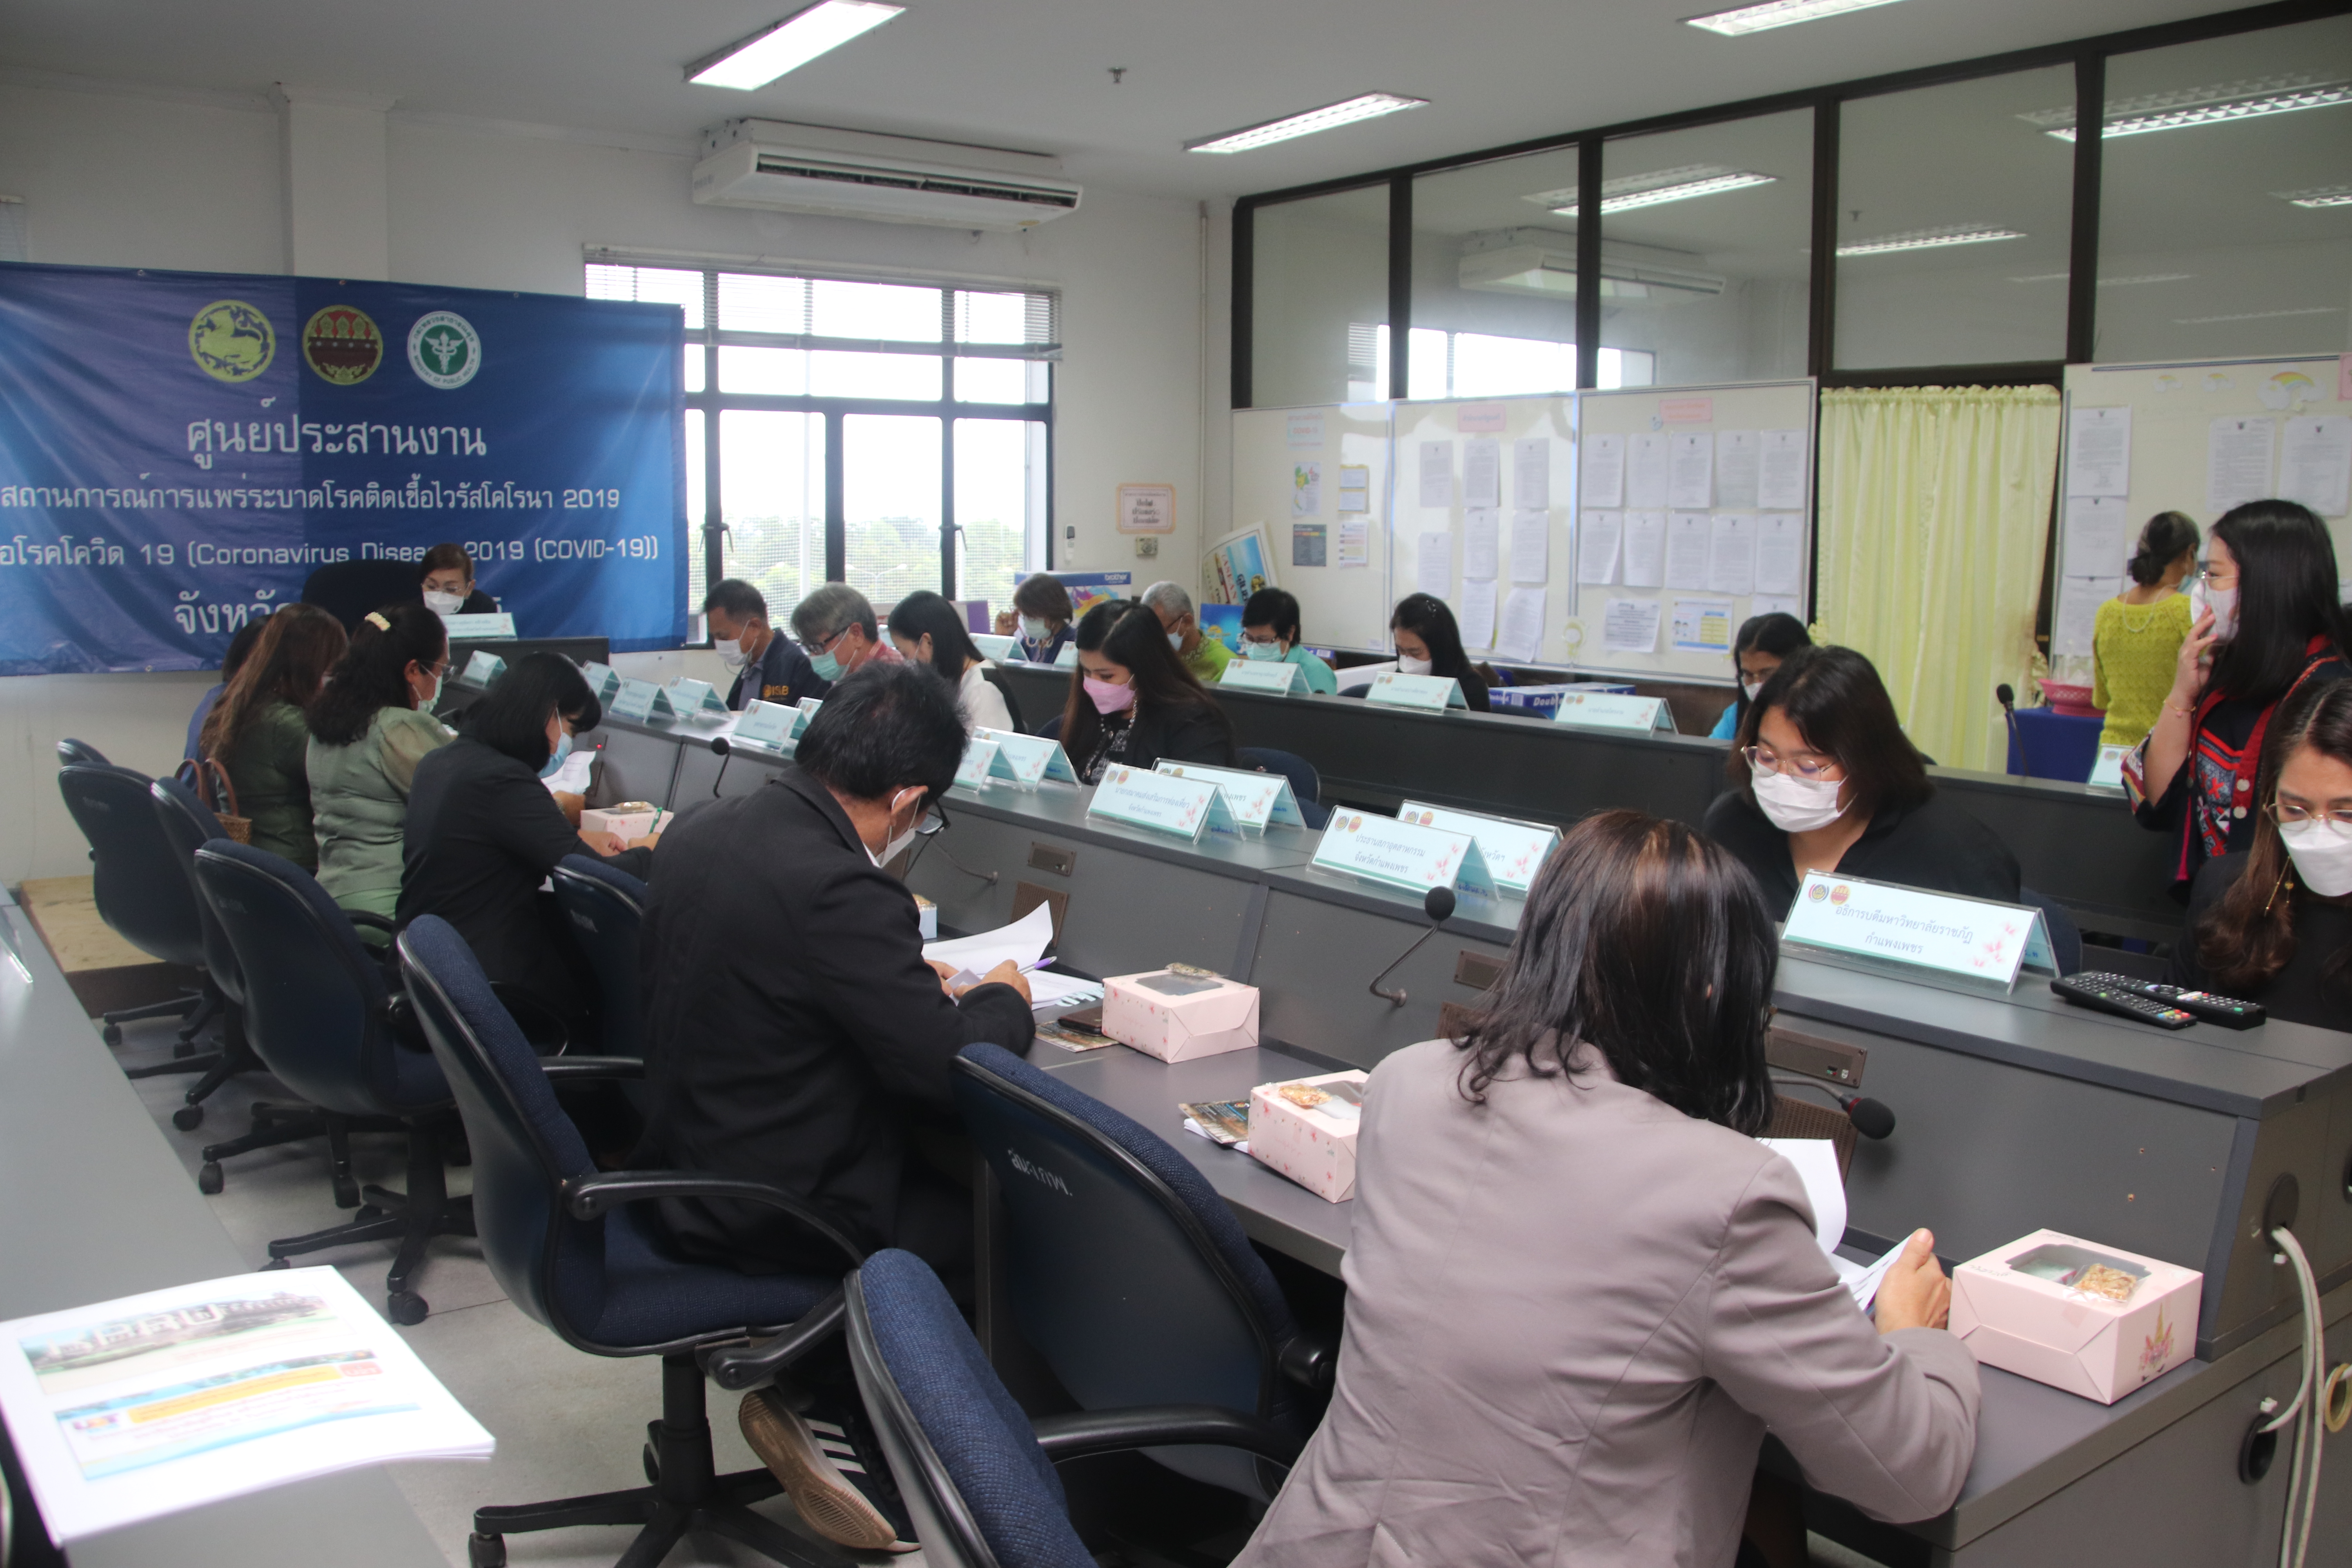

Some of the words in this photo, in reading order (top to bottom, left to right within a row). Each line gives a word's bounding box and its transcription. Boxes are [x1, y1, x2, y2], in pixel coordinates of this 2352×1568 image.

[187, 396, 486, 470] ศูนย์ประสานงาน
[1, 472, 554, 508] สถานการณ์การแพร่ระบาดโรคติดเชื้อไวรัสโคโรนา
[564, 489, 620, 509] 2019
[141, 544, 174, 565] 19
[188, 541, 349, 568] (Coronavirus
[464, 541, 524, 561] 2019
[535, 535, 659, 562] (COVID-19))
[1115, 786, 1190, 809] นายกสมาคมส่งเสริมการท่องเที่ยว
[1128, 803, 1162, 818] จังหวัดกำแพงเพชร
[1355, 833, 1426, 858] ประธานสภาอุตสาหกรรม
[1355, 851, 1409, 874] จังหวัดกำแพงเพชร
[1835, 903, 1974, 945] อธิการบดีมหาวิทยาลัยราชภัฏ
[1864, 931, 1924, 955] กำแพงเพชร
